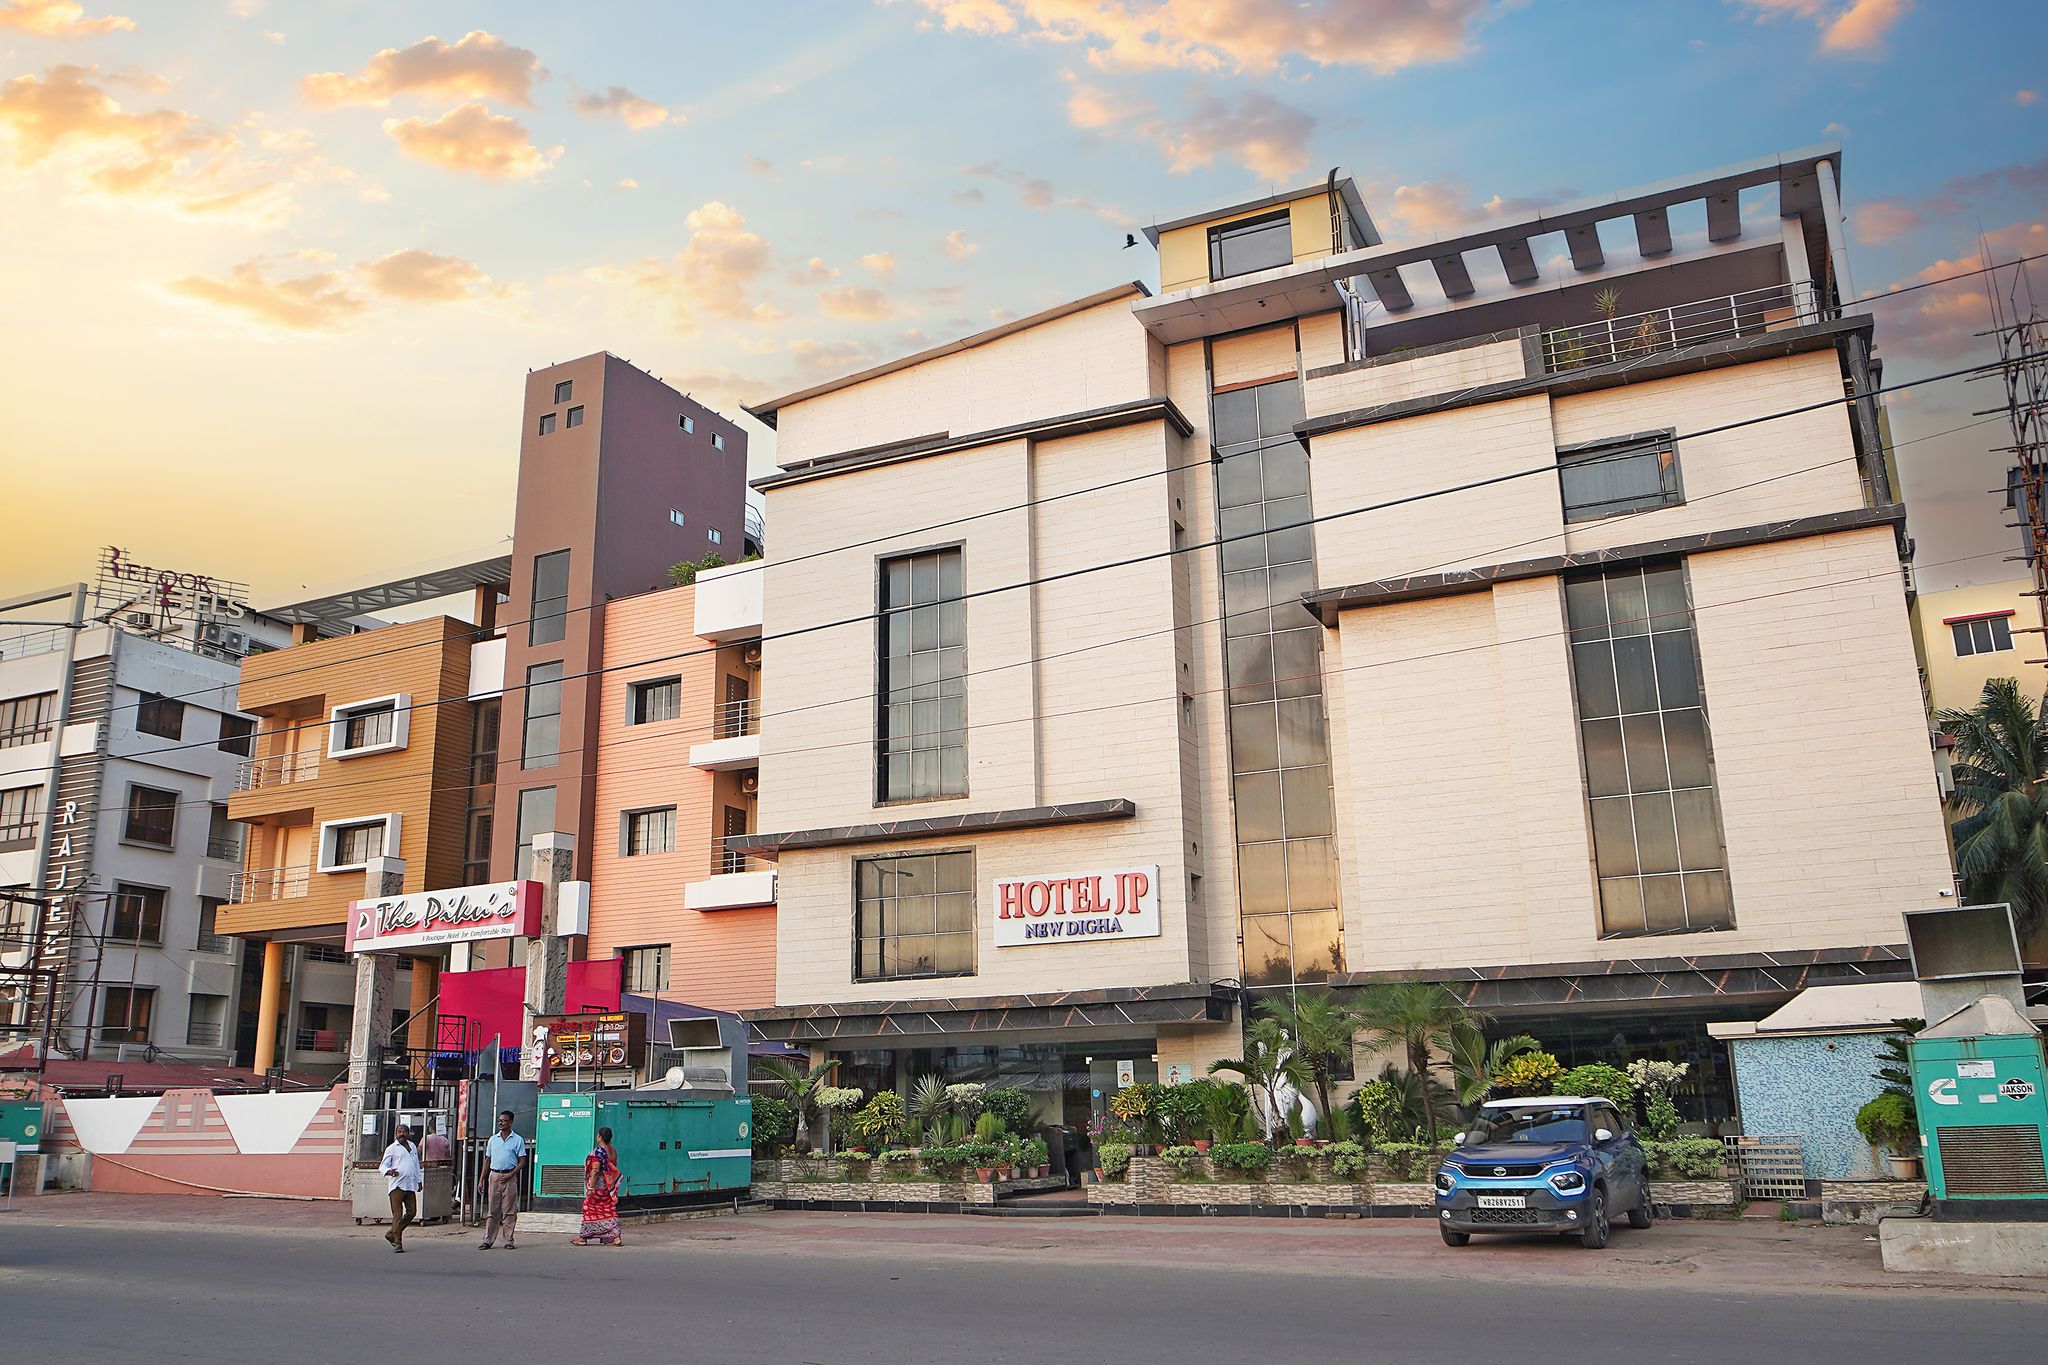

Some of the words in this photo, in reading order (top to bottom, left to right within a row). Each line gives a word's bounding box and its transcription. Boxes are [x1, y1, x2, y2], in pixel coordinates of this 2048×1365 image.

[108, 545, 213, 594] RELOOK
[134, 583, 245, 619] HTELS
[376, 900, 417, 934] The
[423, 893, 514, 929] Piku's
[998, 876, 1111, 919] HOTEL
[1114, 872, 1149, 915] JP
[470, 928, 499, 938] Comfortable
[500, 927, 512, 936] Stay
[1025, 921, 1064, 939] NEW
[1066, 917, 1123, 937] DIGHA
[2001, 1085, 2033, 1094] JAKSON
